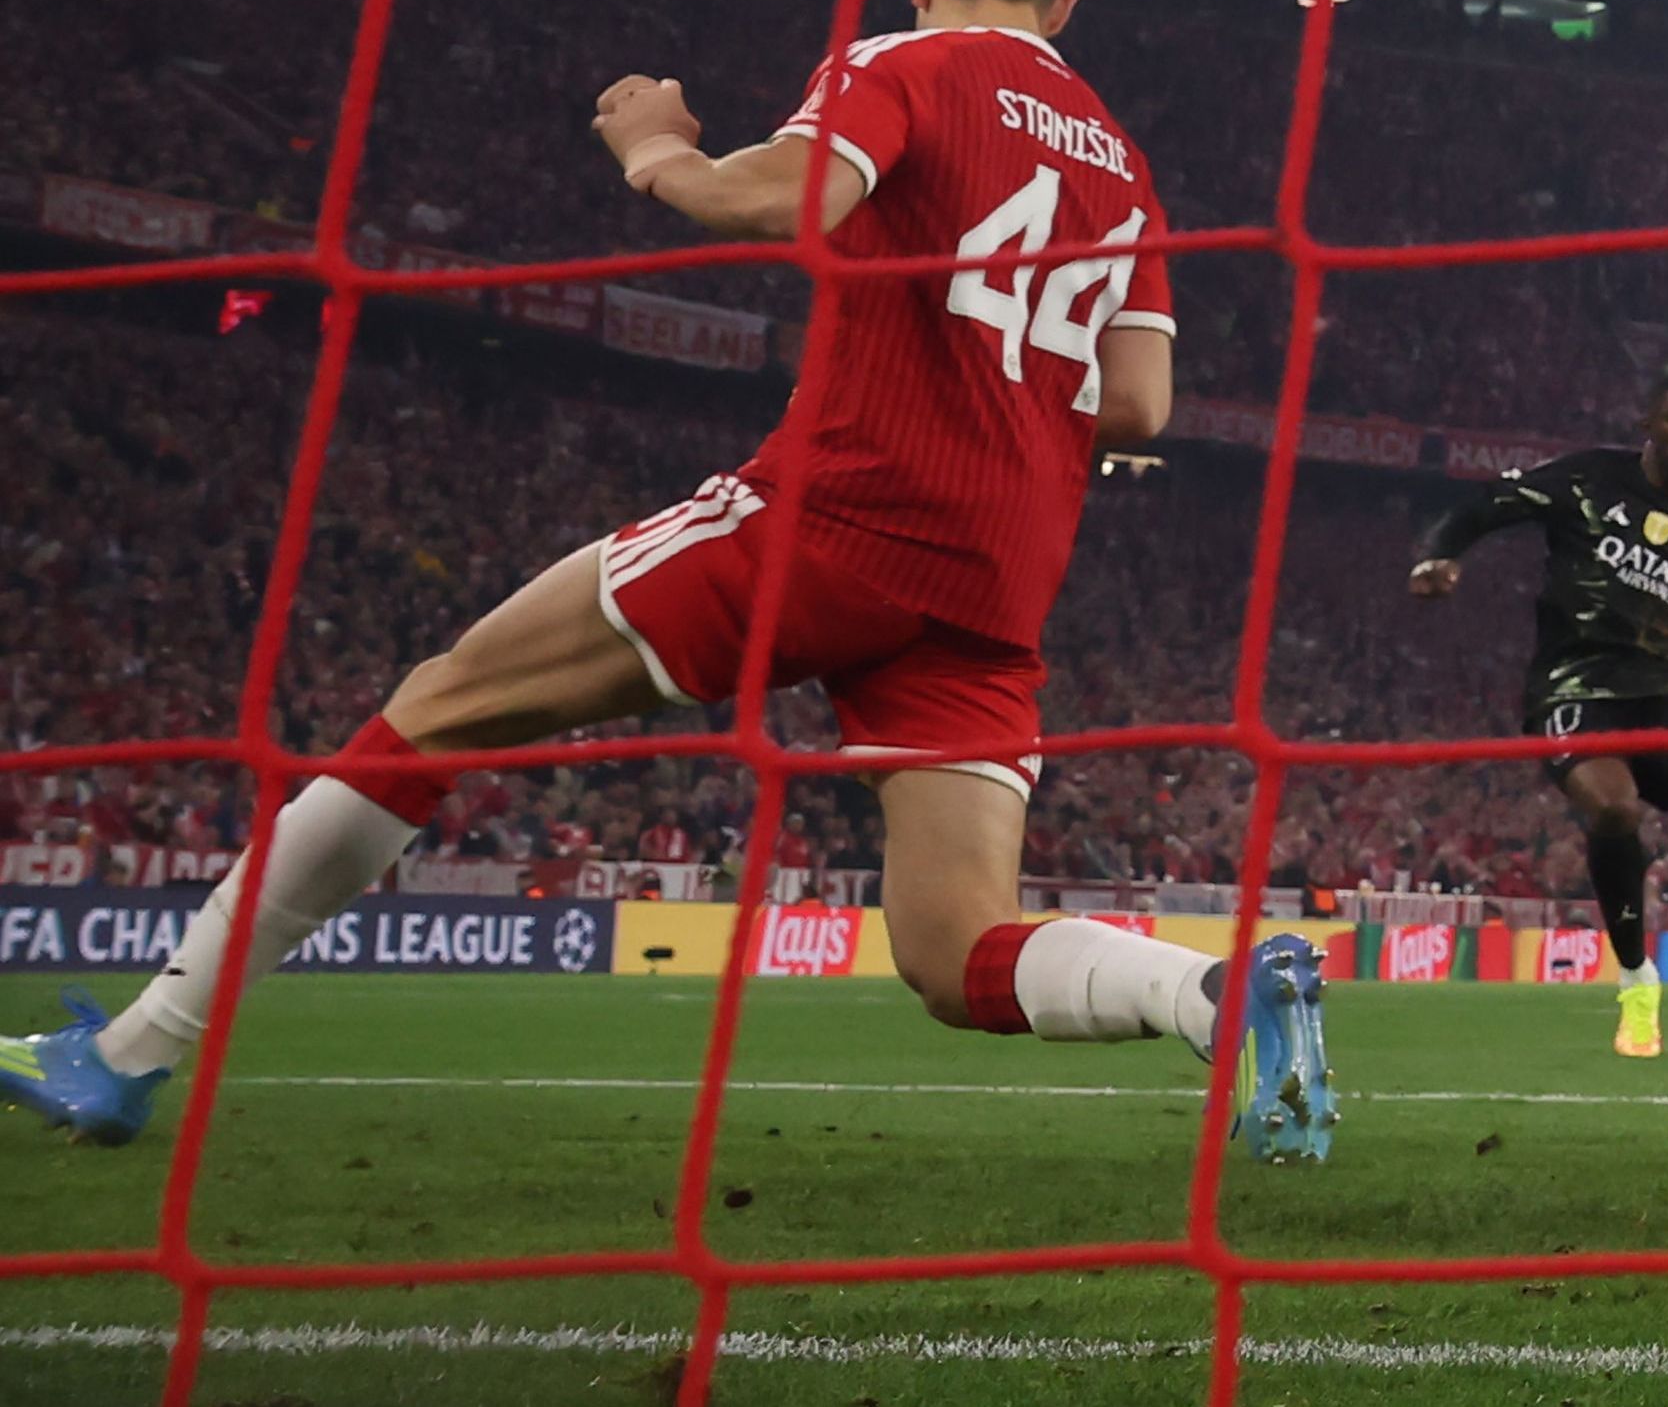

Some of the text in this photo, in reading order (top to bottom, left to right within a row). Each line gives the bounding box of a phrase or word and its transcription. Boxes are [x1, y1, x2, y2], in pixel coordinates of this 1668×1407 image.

[996, 87, 1135, 183] STANIŠIĆ
[946, 163, 1148, 416] 44
[0, 906, 536, 964] FA CHANS LEAGUE
[756, 905, 854, 975] Lay's
